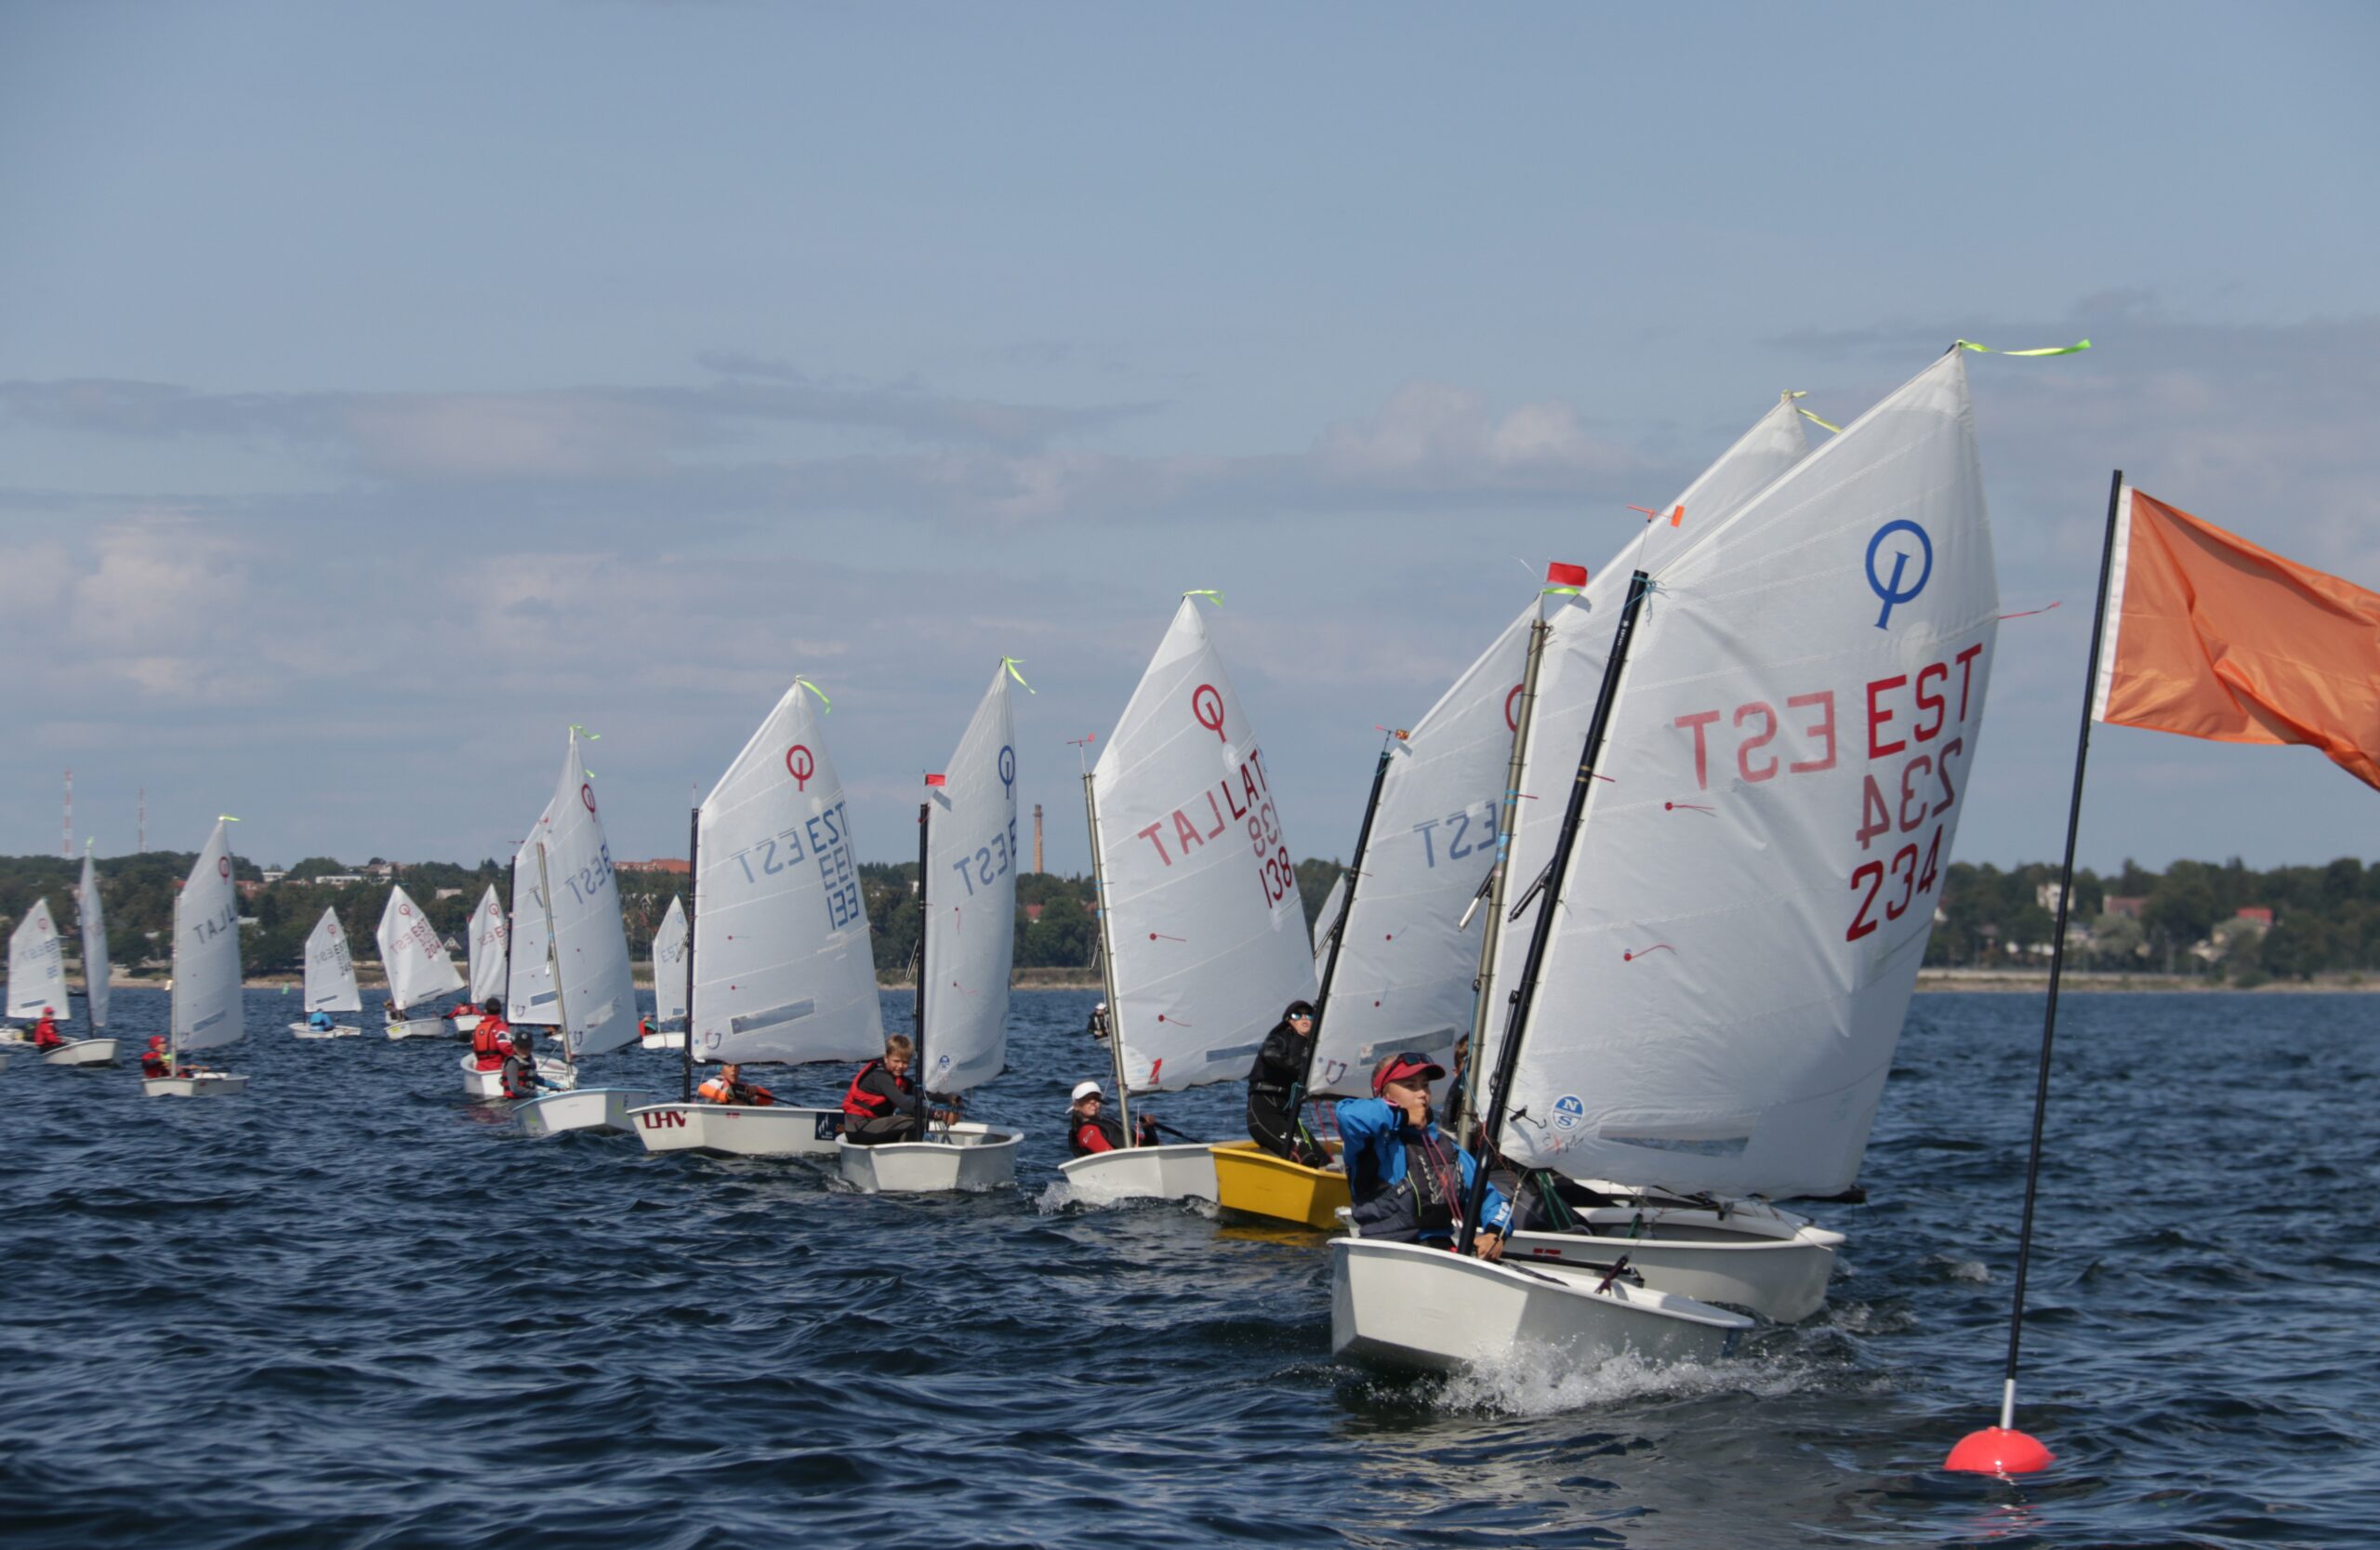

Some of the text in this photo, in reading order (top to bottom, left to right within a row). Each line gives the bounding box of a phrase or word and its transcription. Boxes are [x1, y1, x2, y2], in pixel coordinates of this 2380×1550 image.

[1867, 643, 1982, 760] EST
[1221, 749, 1266, 820] LAT
[806, 801, 847, 854] EST
[1259, 846, 1292, 908] 138
[1846, 824, 1943, 942] 234
[826, 882, 859, 930] 133
[643, 1111, 686, 1129] LHV
[1563, 1098, 1579, 1111] N
